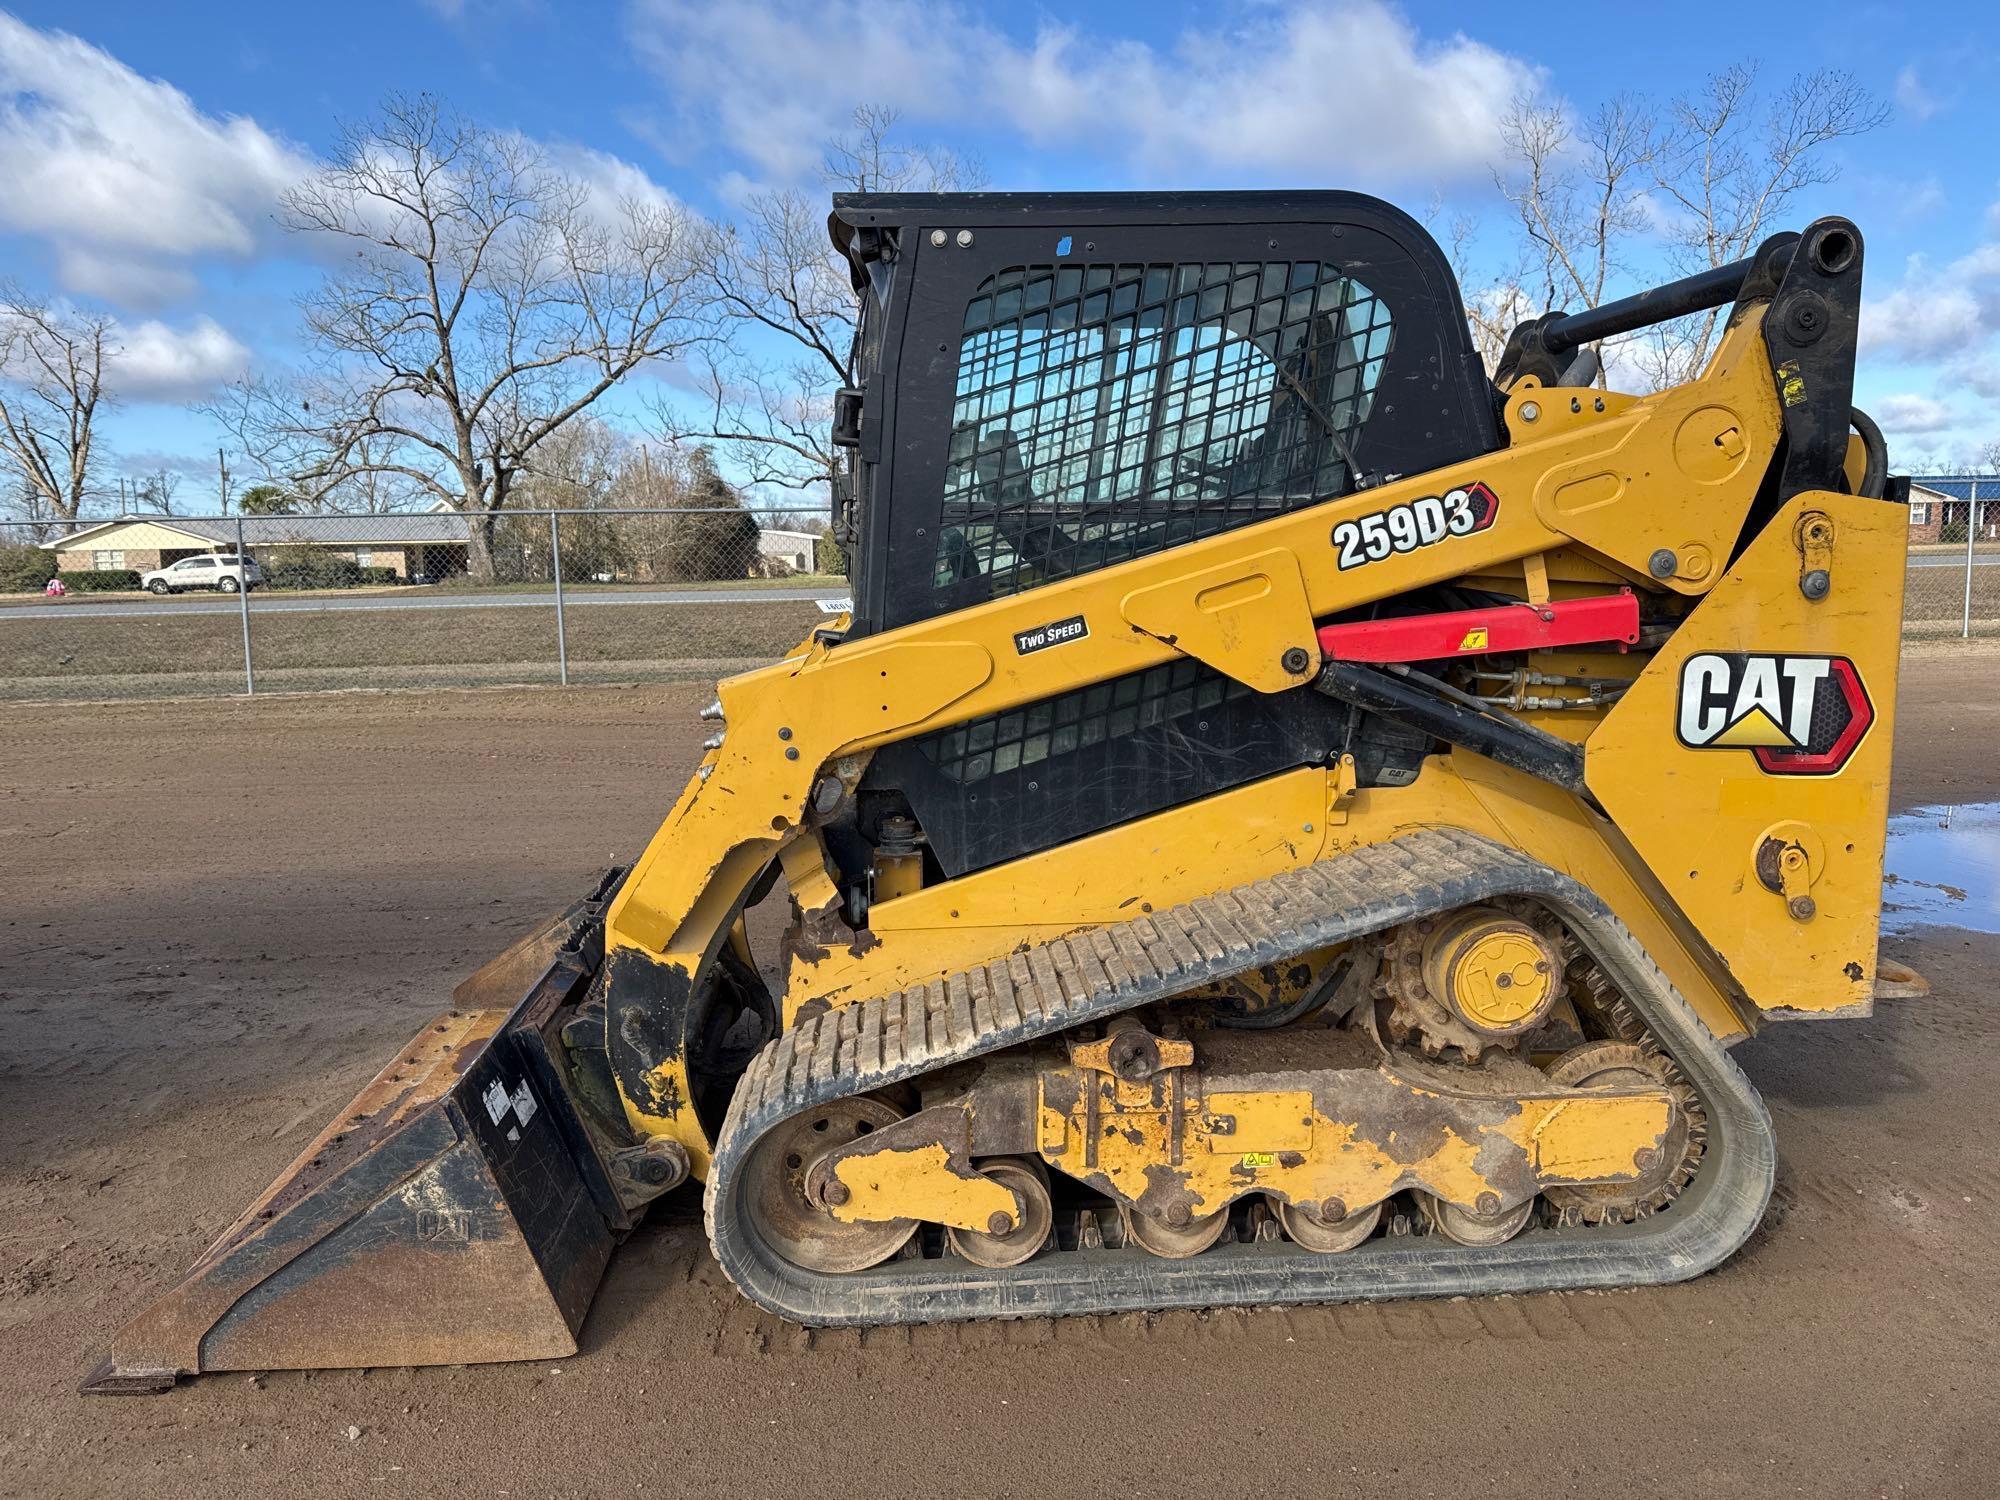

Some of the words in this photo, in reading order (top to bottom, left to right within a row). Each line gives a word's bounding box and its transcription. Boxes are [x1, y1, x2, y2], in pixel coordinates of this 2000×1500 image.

[1333, 489, 1475, 569] 259D3
[1019, 634, 1045, 650] TWO
[1047, 622, 1082, 642] SPEED
[1680, 655, 1831, 747] CAT
[1388, 769, 1407, 777] CAT
[416, 1209, 472, 1242] CAT
